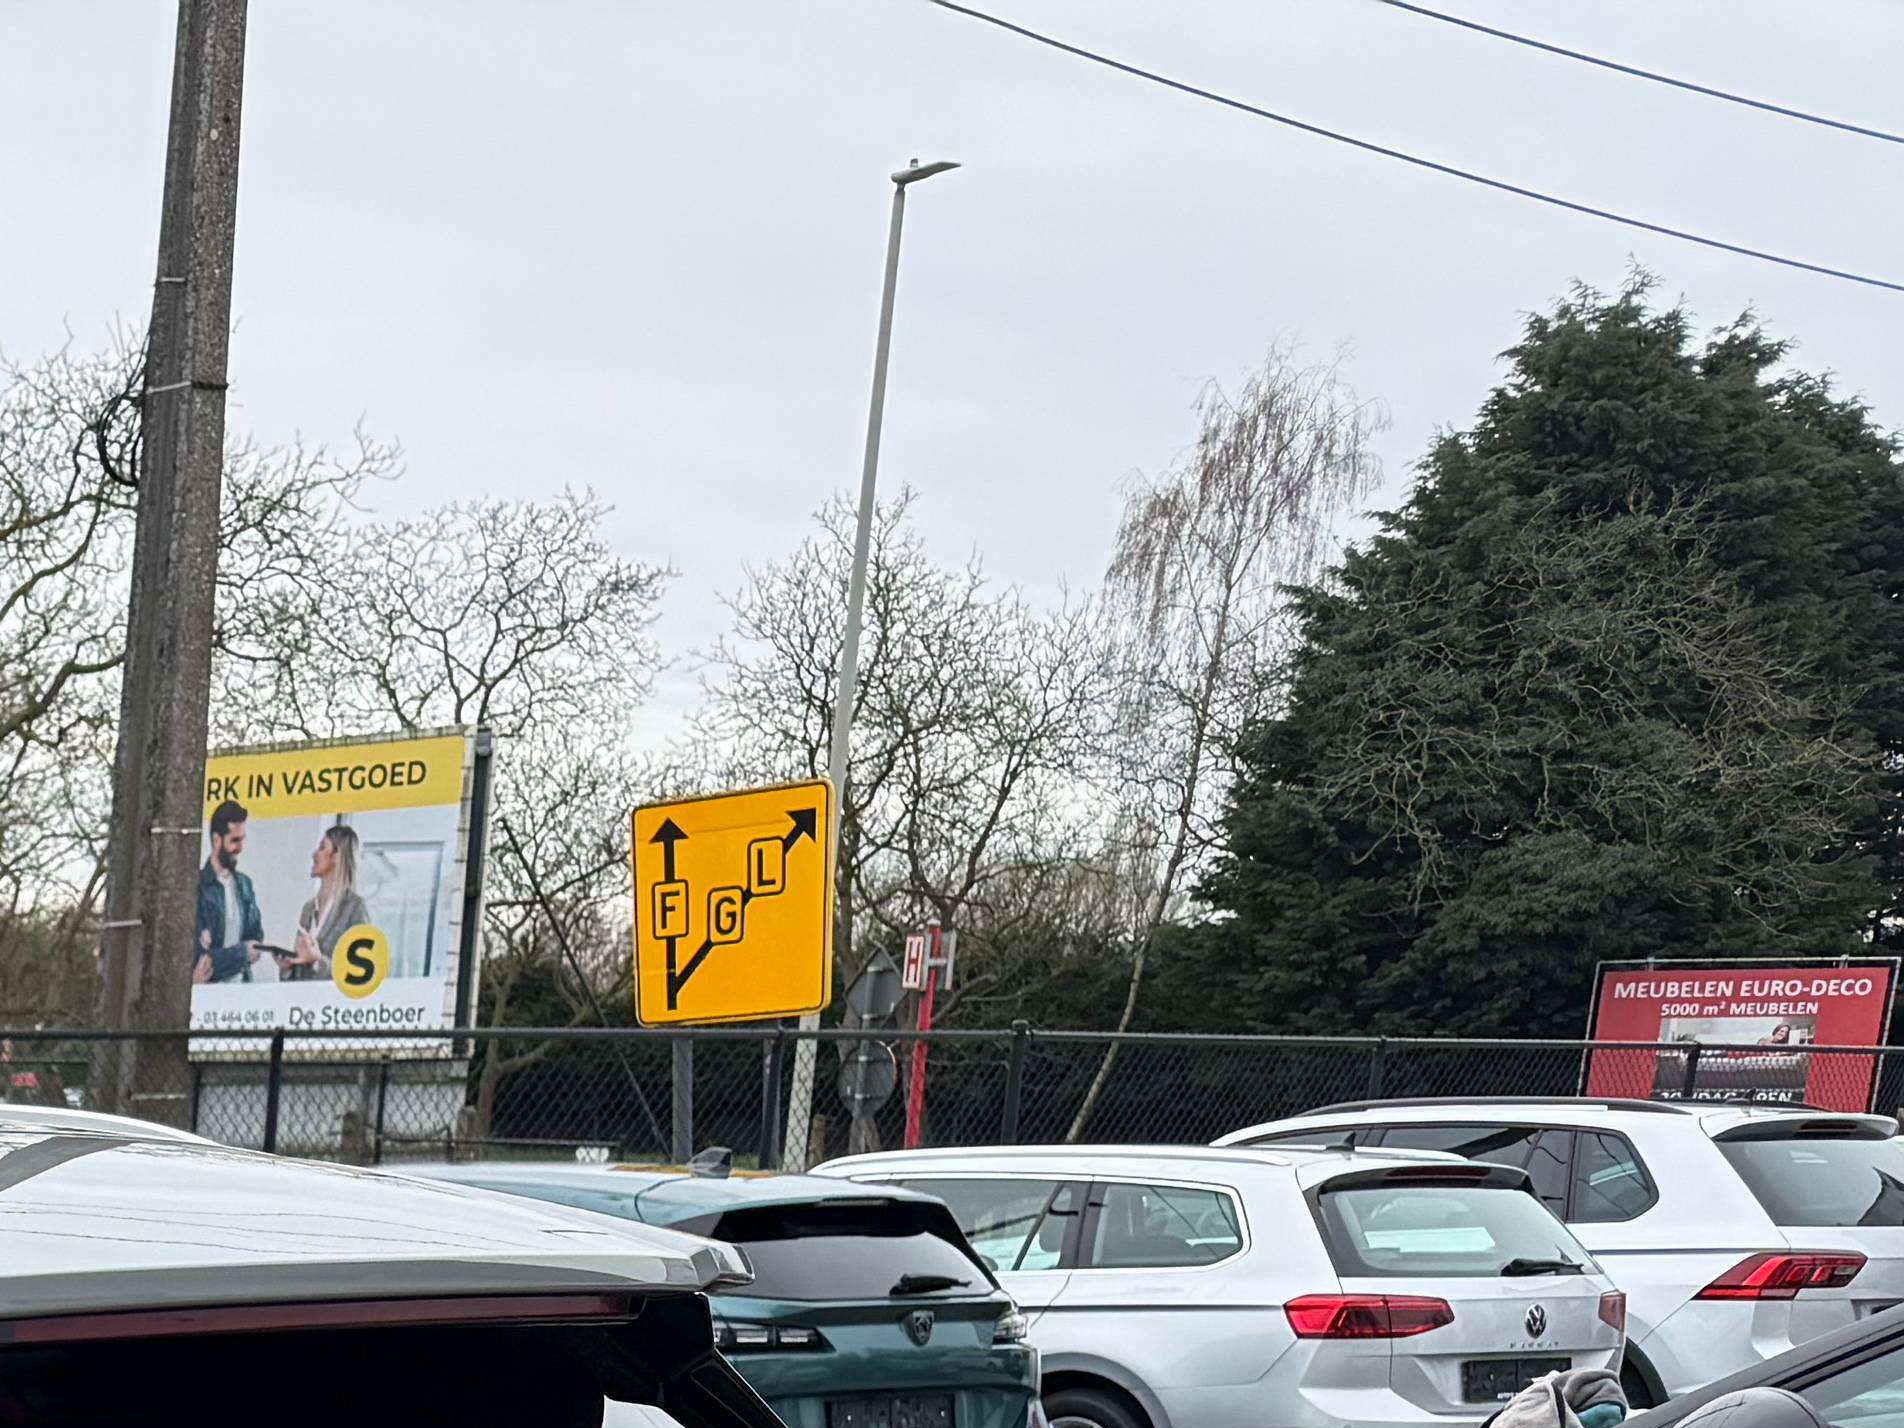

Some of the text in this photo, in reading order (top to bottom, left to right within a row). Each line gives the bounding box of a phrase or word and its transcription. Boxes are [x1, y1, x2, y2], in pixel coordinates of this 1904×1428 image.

[207, 760, 426, 801] RK IN VASTGOED
[757, 848, 776, 887] L
[660, 890, 680, 929] F
[715, 896, 737, 935] G
[344, 938, 375, 986] S
[1614, 979, 1873, 999] MEUBELEN EURO-DECO
[289, 1003, 426, 1026] De Steenboer
[1661, 1003, 1699, 1016] 5000
[1729, 1002, 1818, 1016] MEUBELEN
